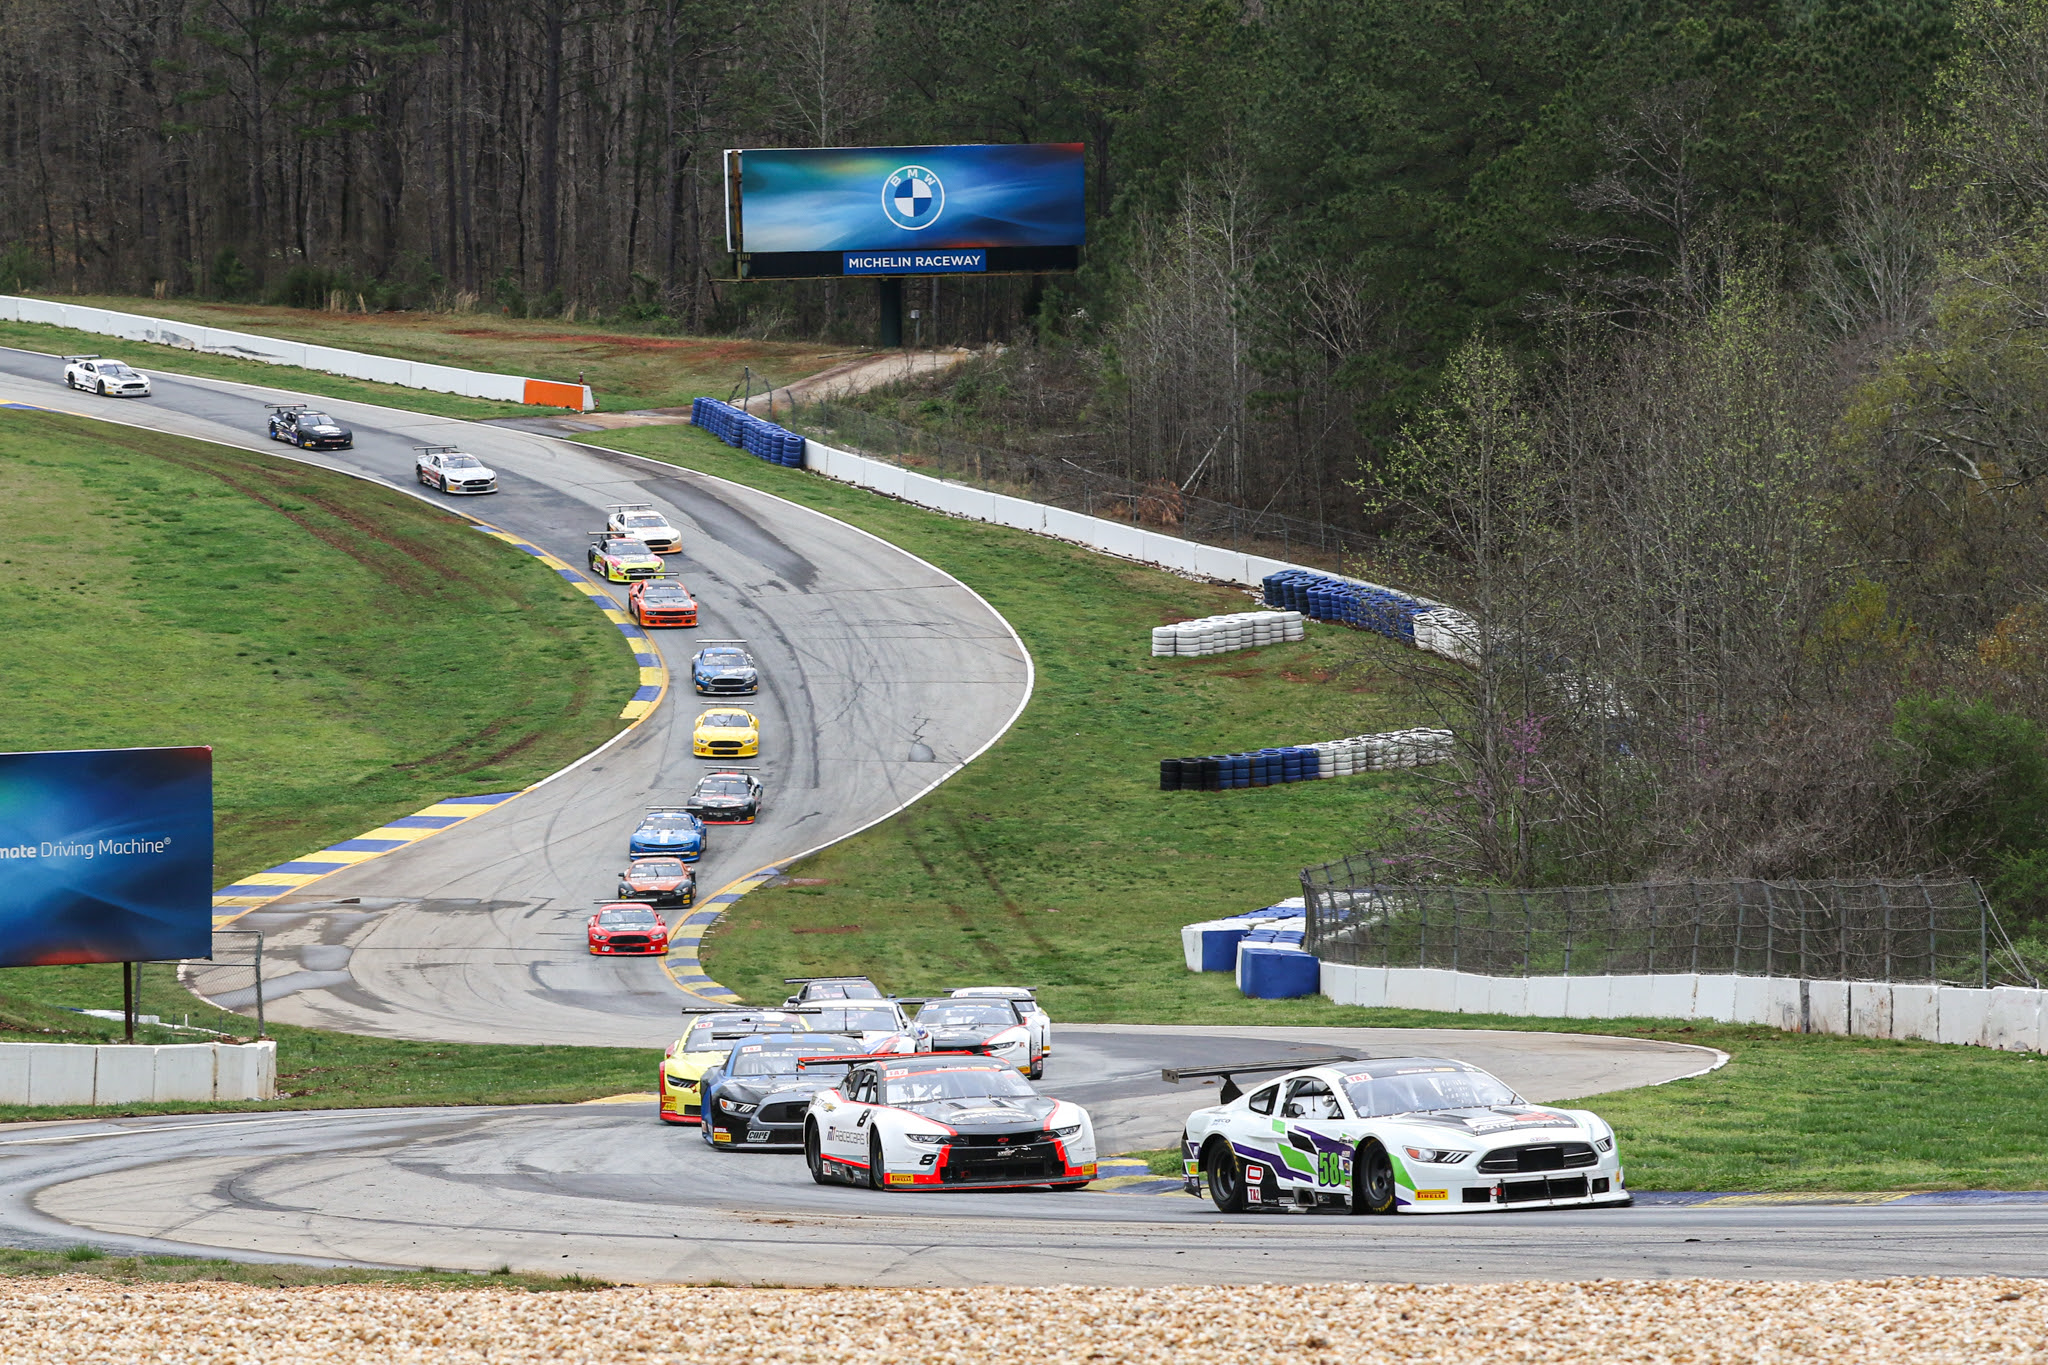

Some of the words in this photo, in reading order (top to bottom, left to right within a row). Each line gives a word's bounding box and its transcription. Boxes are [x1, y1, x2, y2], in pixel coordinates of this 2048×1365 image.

[889, 168, 936, 188] BMW
[848, 257, 911, 268] MICHELIN
[915, 255, 981, 267] RACEWAY
[41, 841, 94, 860] Driving
[1350, 1074, 1369, 1082] TA2
[857, 1108, 872, 1127] 8
[919, 1154, 937, 1165] 8
[1318, 1151, 1341, 1187] 58
[1249, 1189, 1260, 1201] TA2
[1417, 1190, 1446, 1199] PIRELLI
